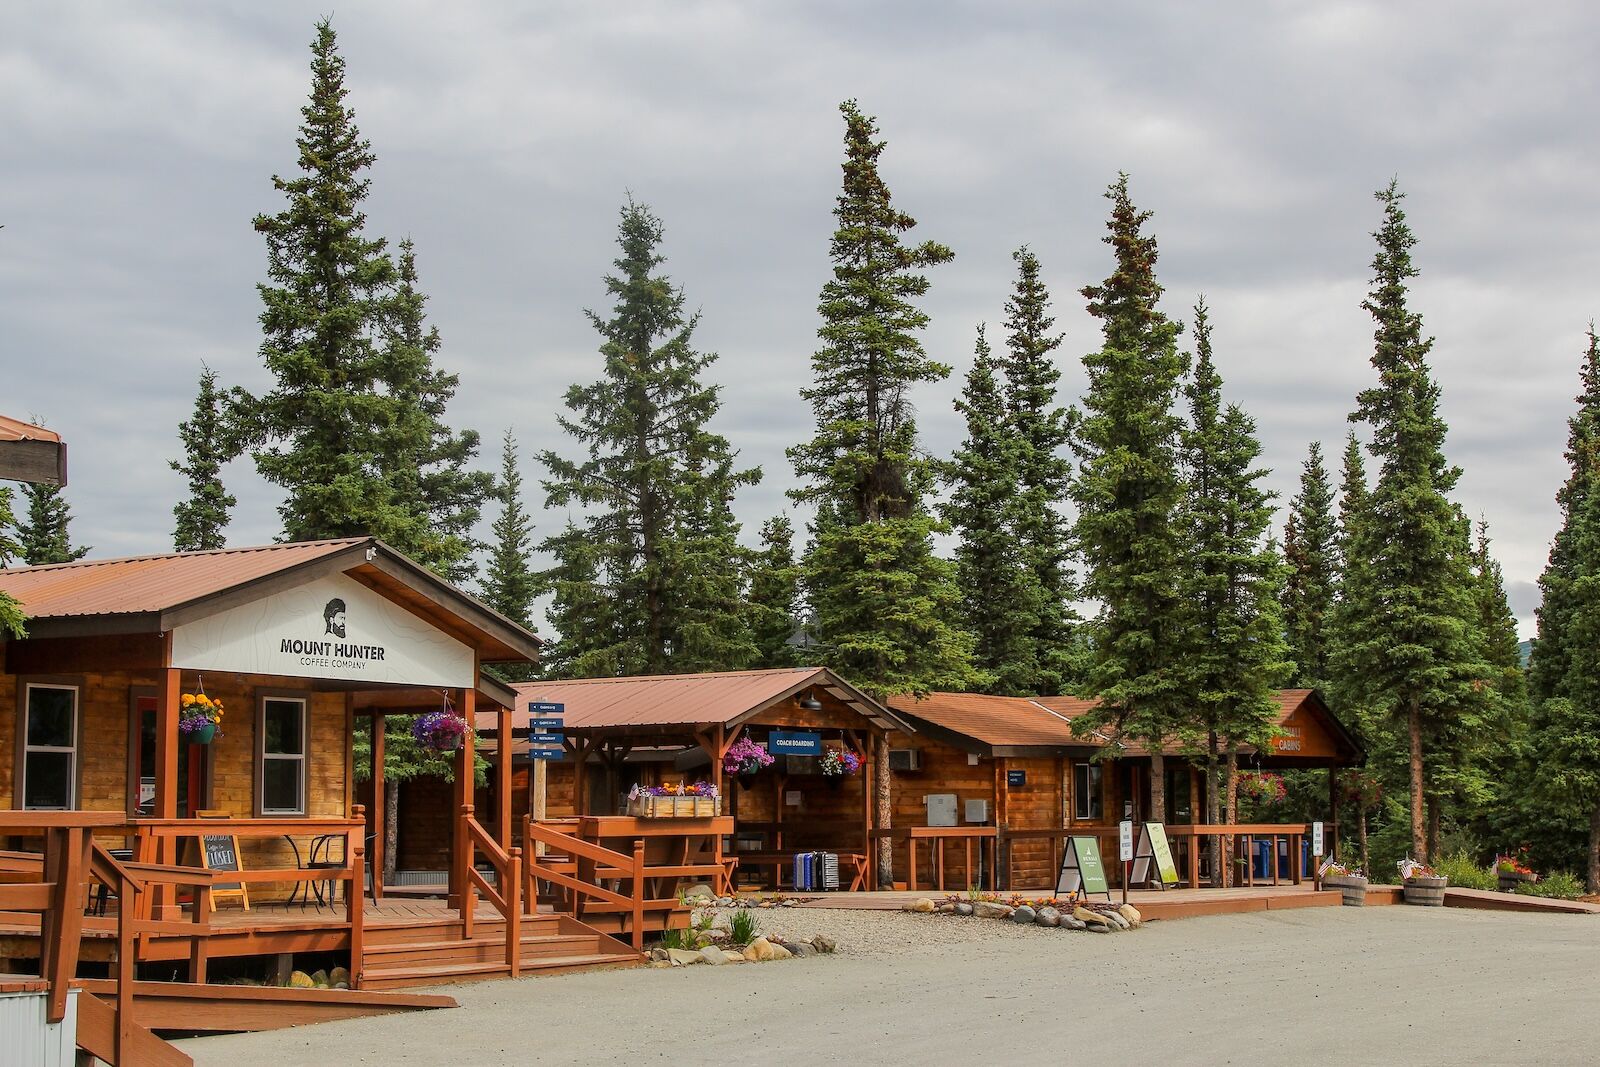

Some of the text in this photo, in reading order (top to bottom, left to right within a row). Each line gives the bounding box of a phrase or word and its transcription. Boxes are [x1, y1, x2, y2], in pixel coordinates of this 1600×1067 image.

[280, 638, 385, 661] MOUNT HUNTER
[300, 657, 366, 670] COFFEE COMPANY
[776, 739, 792, 747] COACH
[1278, 739, 1301, 751] CABINS
[206, 849, 235, 867] CLOSED
